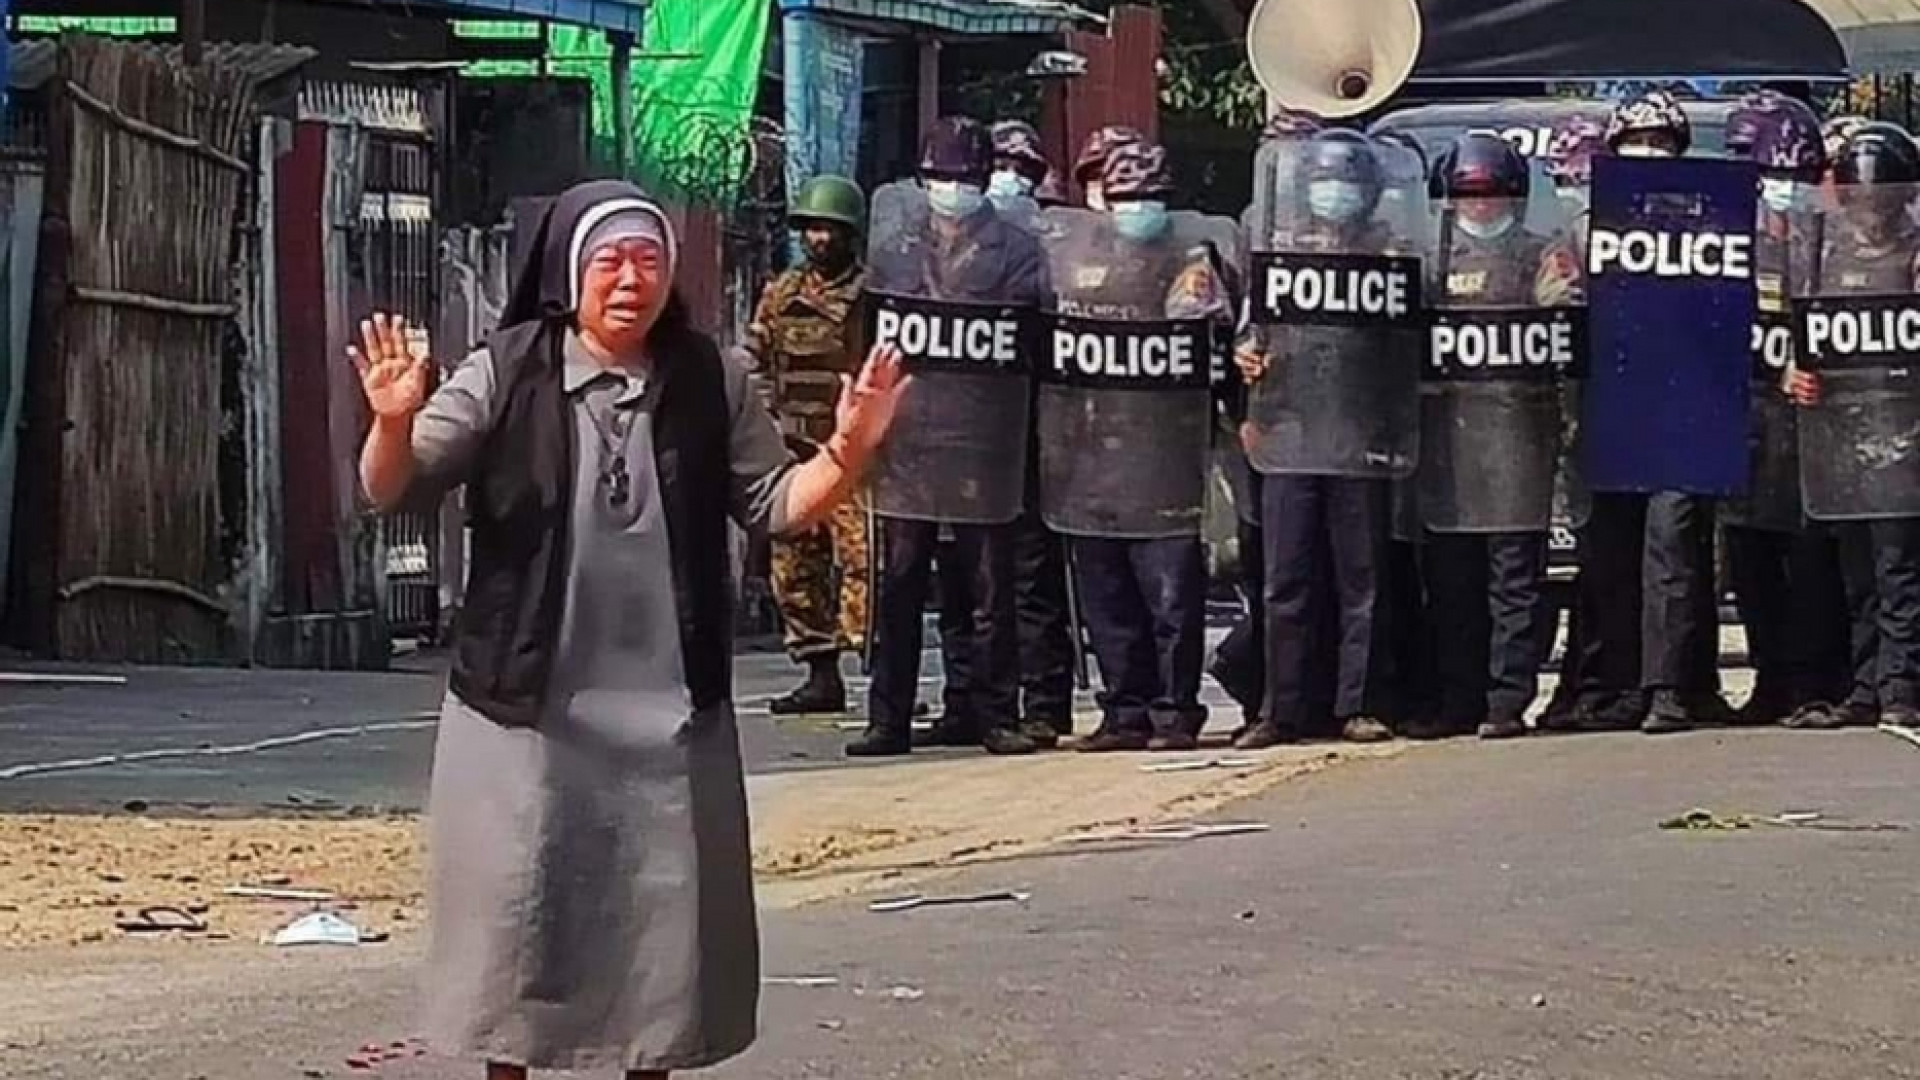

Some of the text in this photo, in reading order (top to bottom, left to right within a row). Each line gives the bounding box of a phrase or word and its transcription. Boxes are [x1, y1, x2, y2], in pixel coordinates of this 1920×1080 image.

[1590, 229, 1751, 278] POLICE
[1266, 267, 1407, 314] POLICE
[877, 309, 1018, 360] POLICE
[1054, 331, 1193, 376] POLICE
[1431, 323, 1573, 367] POLICE
[1807, 308, 1920, 353] POLIC
